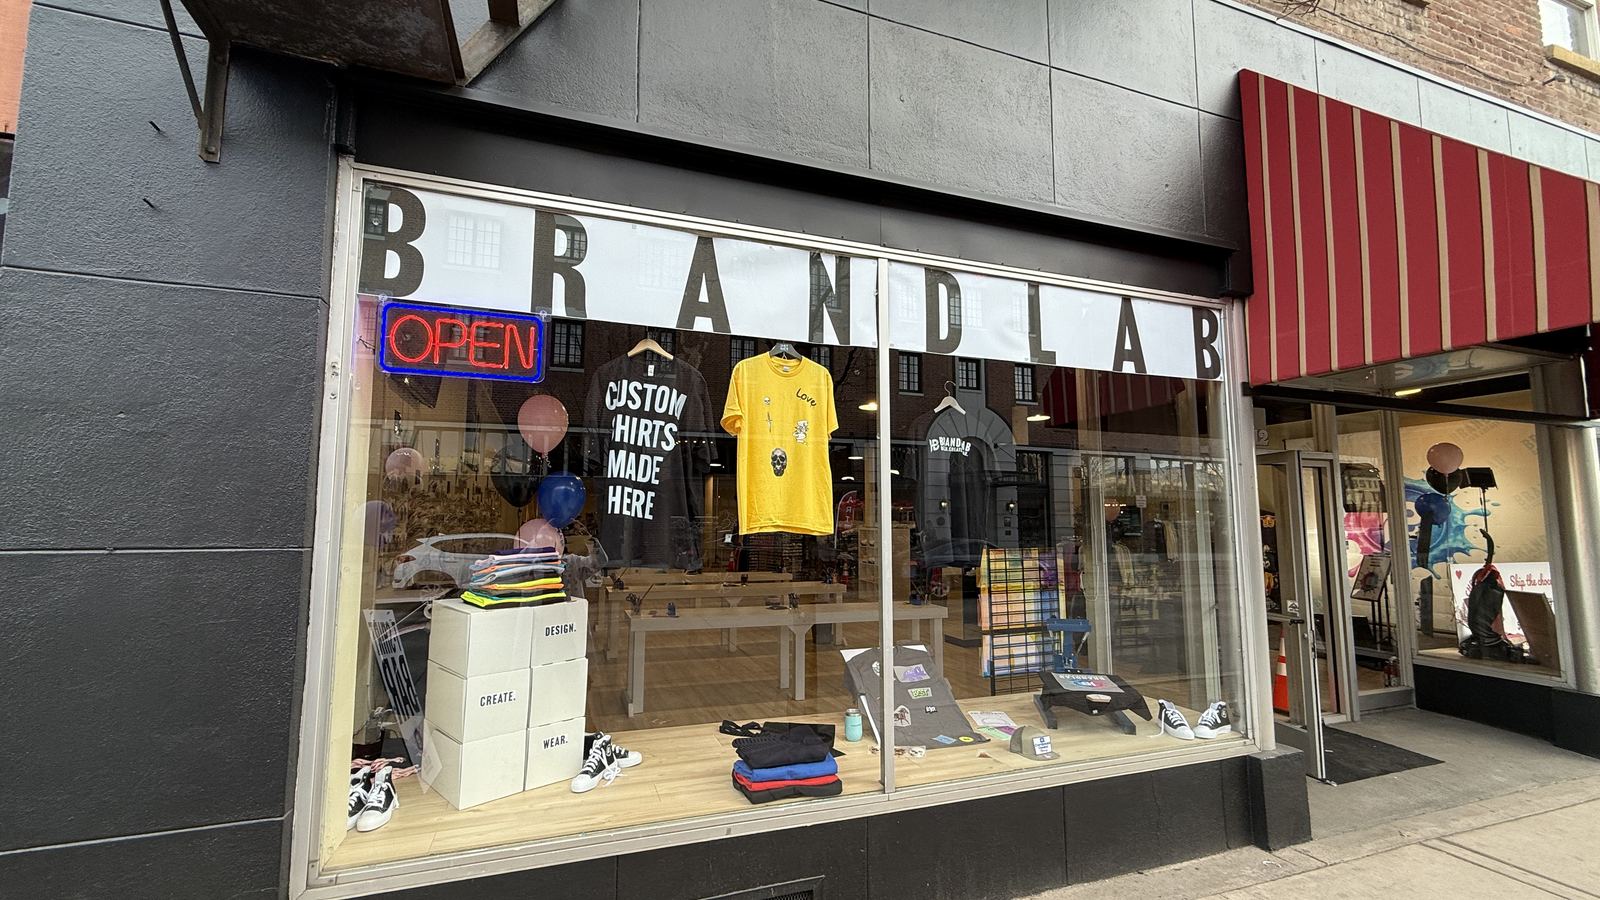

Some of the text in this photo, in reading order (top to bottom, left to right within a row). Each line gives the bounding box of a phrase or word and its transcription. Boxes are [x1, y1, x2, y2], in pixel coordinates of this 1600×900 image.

[390, 315, 535, 369] OPEN
[605, 379, 687, 420] CUSTOM
[796, 388, 817, 407] Love
[612, 414, 678, 452] HIRTS
[608, 449, 663, 485] MADE
[608, 485, 655, 521] HERE
[1510, 573, 1526, 591] Skip
[1526, 573, 1537, 586] the
[545, 623, 577, 637] DESIGN.
[480, 691, 516, 707] CREATE.
[543, 735, 569, 749] WEAR.
